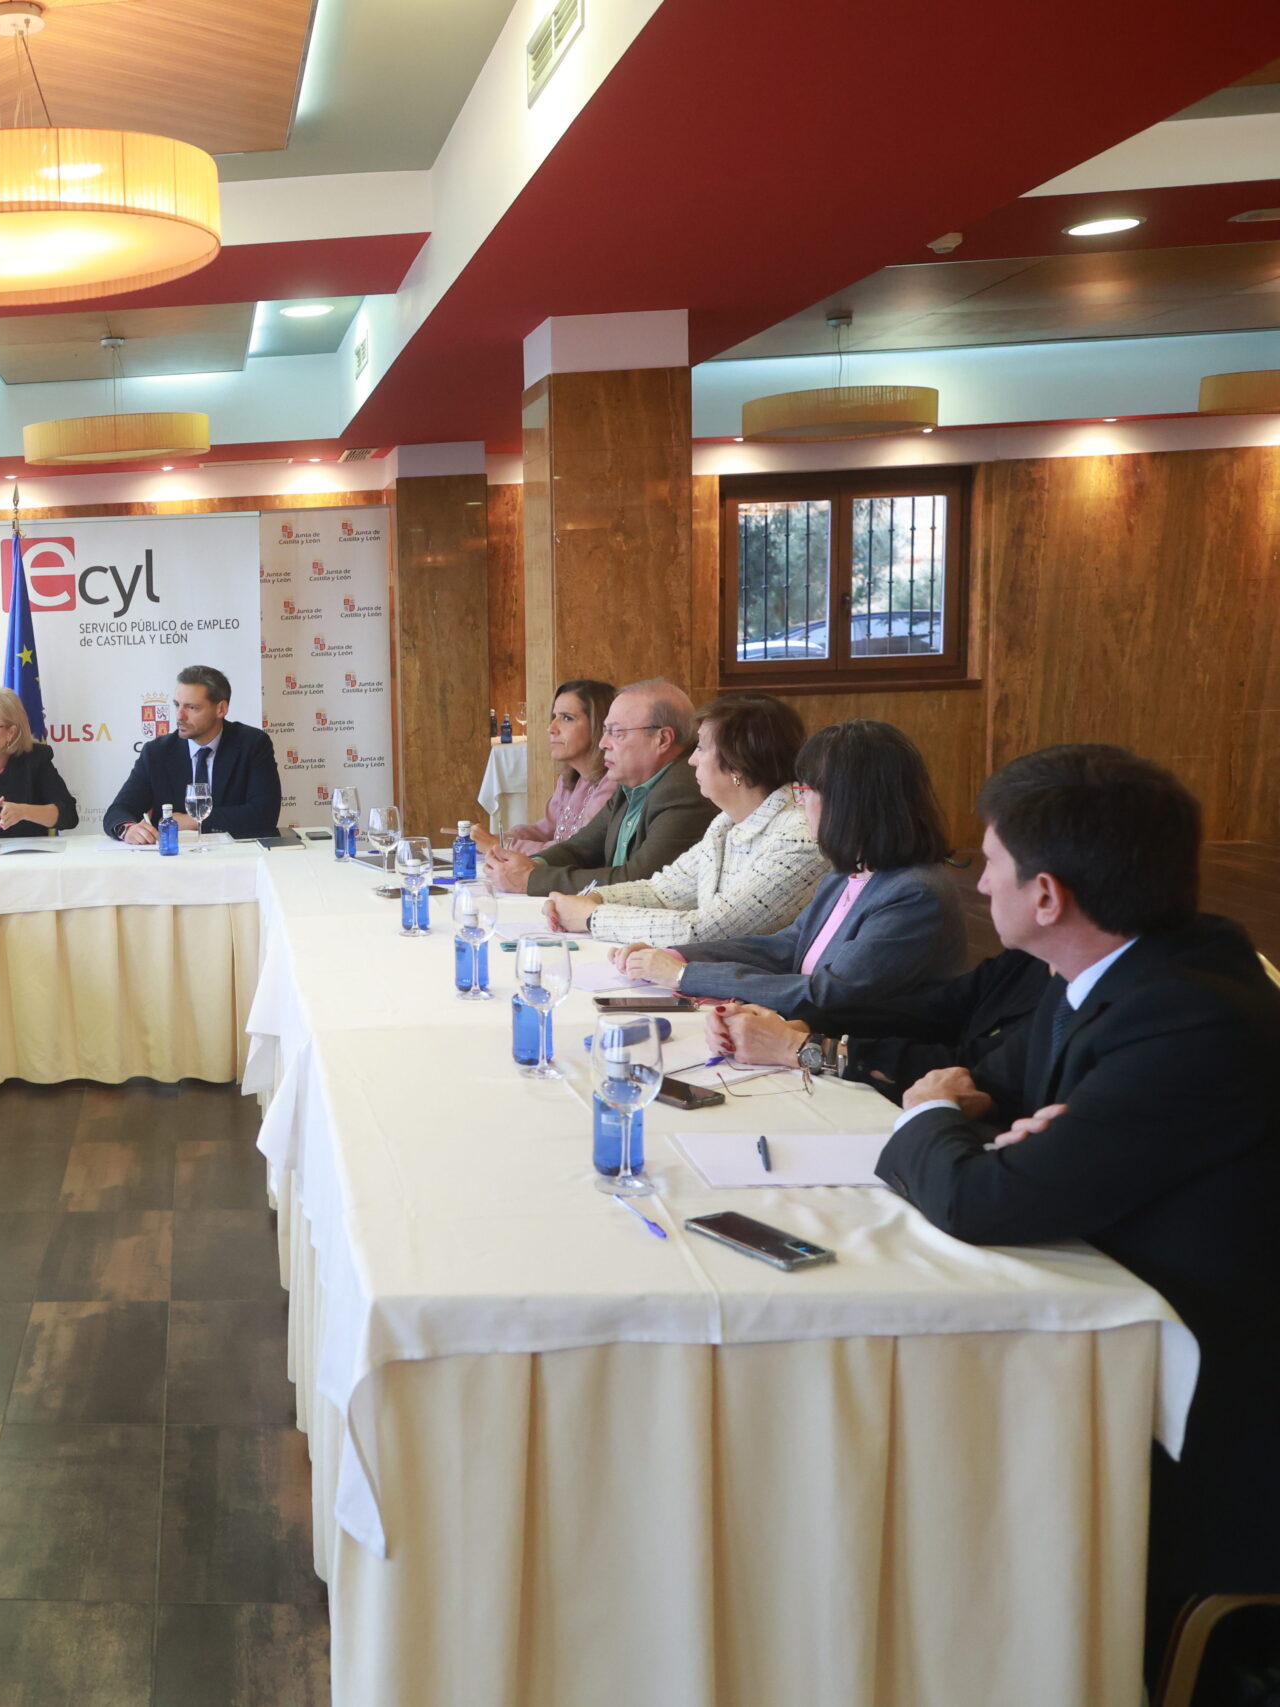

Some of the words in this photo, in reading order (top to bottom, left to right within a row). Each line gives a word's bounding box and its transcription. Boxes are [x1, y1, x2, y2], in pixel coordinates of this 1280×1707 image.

[79, 622, 128, 634] SERVICIO
[131, 619, 177, 632] PÚBLICO
[180, 620, 194, 631] de
[197, 619, 240, 630] EMPLEO
[80, 636, 93, 647] de
[97, 634, 146, 647] CASTILLA
[150, 635, 156, 645] Y
[160, 631, 188, 644] LEÓN
[45, 723, 112, 742] ULSA
